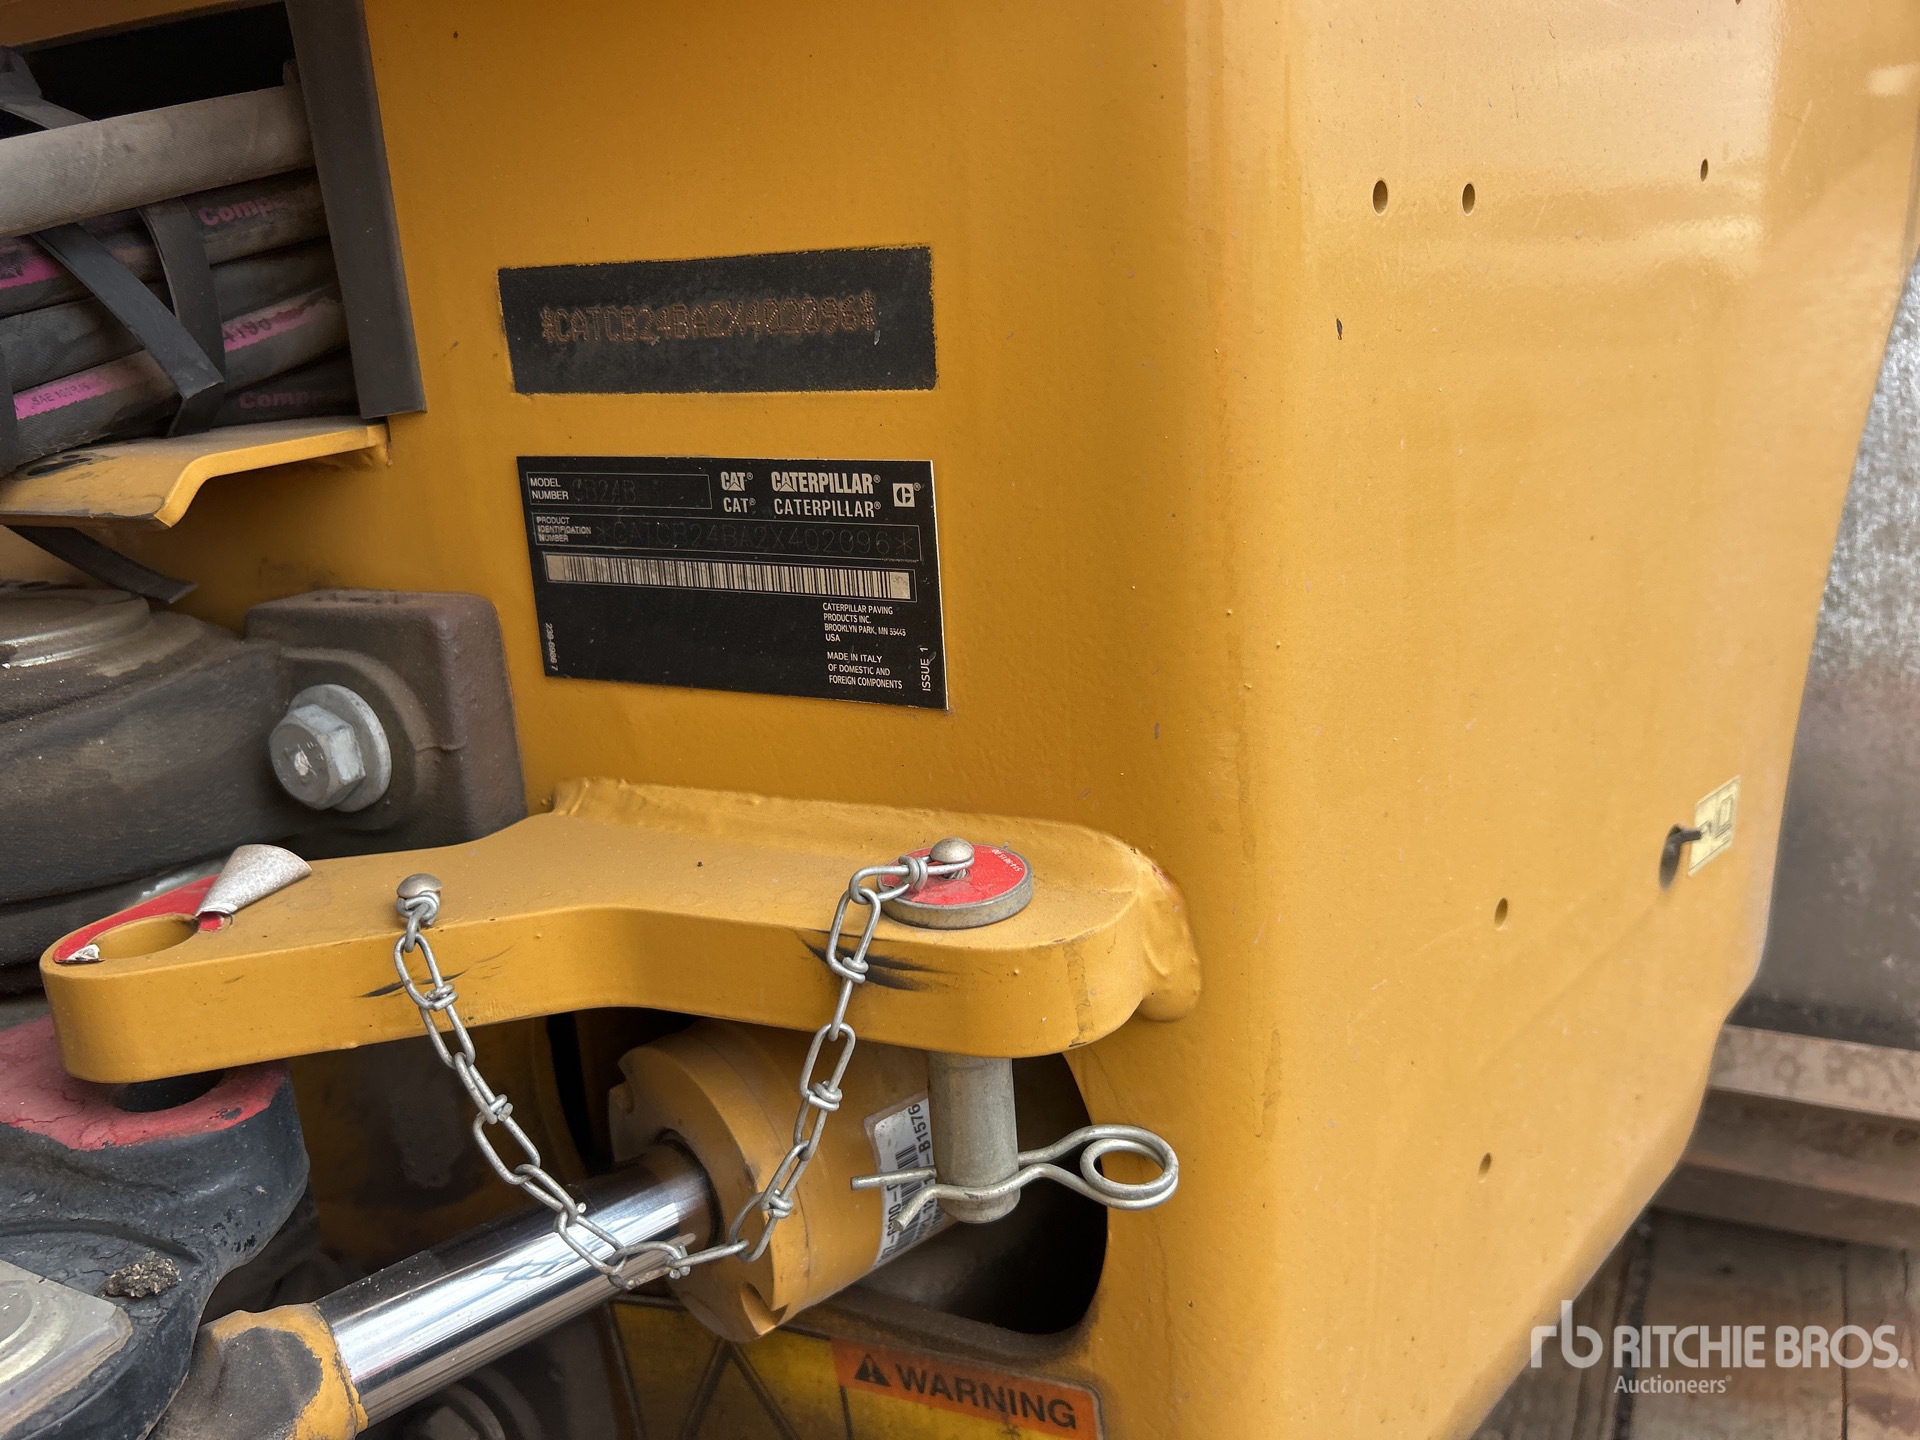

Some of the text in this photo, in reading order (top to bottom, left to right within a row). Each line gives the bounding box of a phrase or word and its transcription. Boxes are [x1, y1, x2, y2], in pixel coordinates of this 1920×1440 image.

[530, 477, 561, 488] MODEL
[532, 490, 569, 501] NUMBER
[536, 516, 570, 525] PRODUCT
[537, 525, 592, 535] IDENTIFICATION
[539, 534, 569, 543] NUMBER
[823, 602, 893, 615] CATERPILLAR PAVING
[823, 613, 872, 624] PRODUCTS INC.
[824, 622, 858, 633] BROOKLYN
[858, 625, 877, 635] PARK,
[878, 627, 888, 635] MN
[825, 633, 841, 642] USA
[827, 651, 882, 663] MADE IN ITALY
[827, 663, 890, 676] OF DOMESTIC AND
[920, 658, 932, 692] ISSUE
[829, 674, 903, 689] FOREIGN COMPONENTS
[895, 1363, 1077, 1429] WARNING
